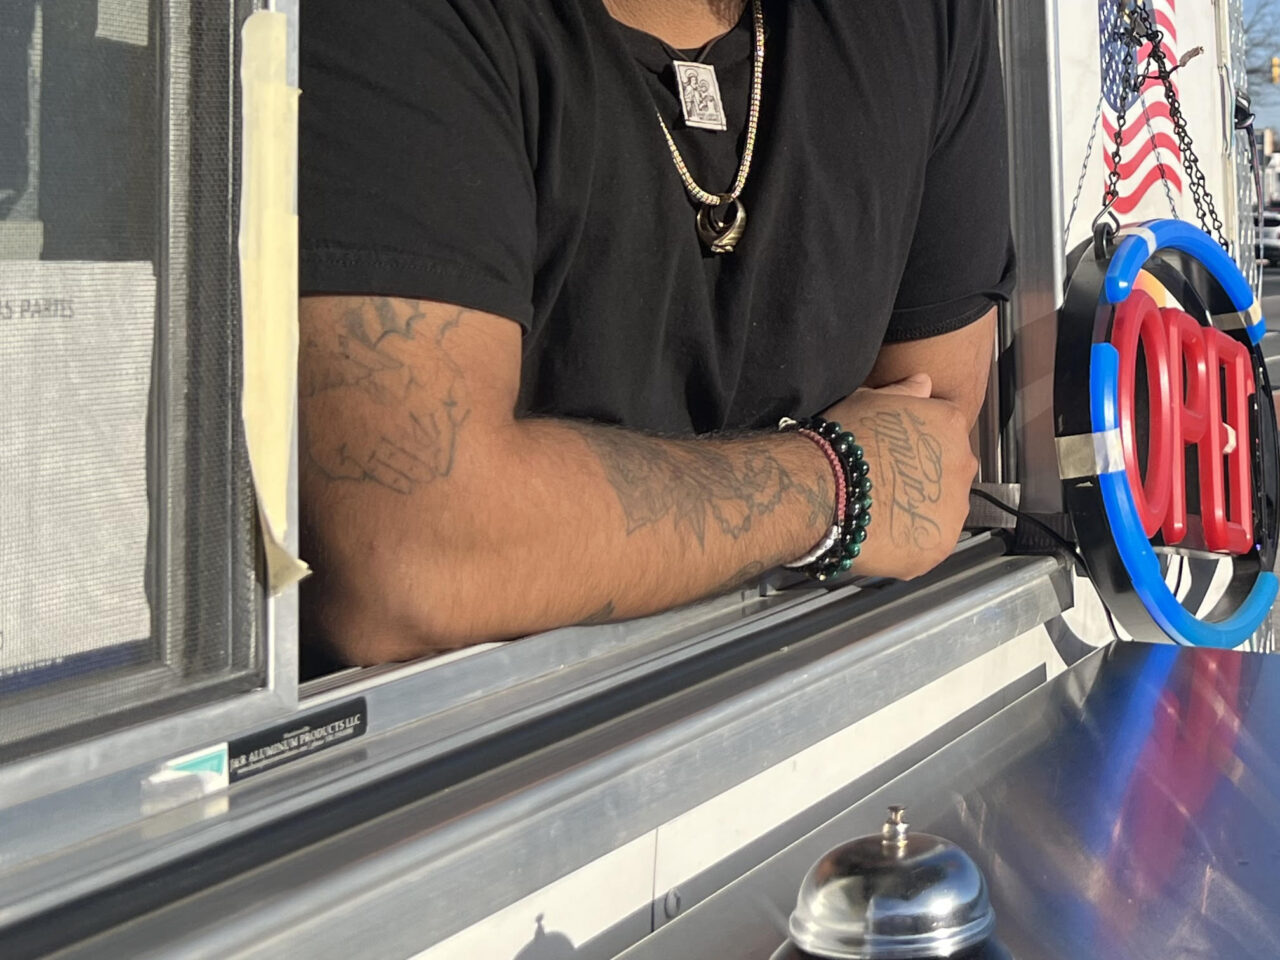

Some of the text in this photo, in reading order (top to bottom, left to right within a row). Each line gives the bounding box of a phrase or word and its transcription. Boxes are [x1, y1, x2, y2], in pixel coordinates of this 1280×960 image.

[248, 736, 299, 762] ALUMINUM
[299, 719, 345, 744] PRODUCTS
[345, 713, 361, 727] LLC
